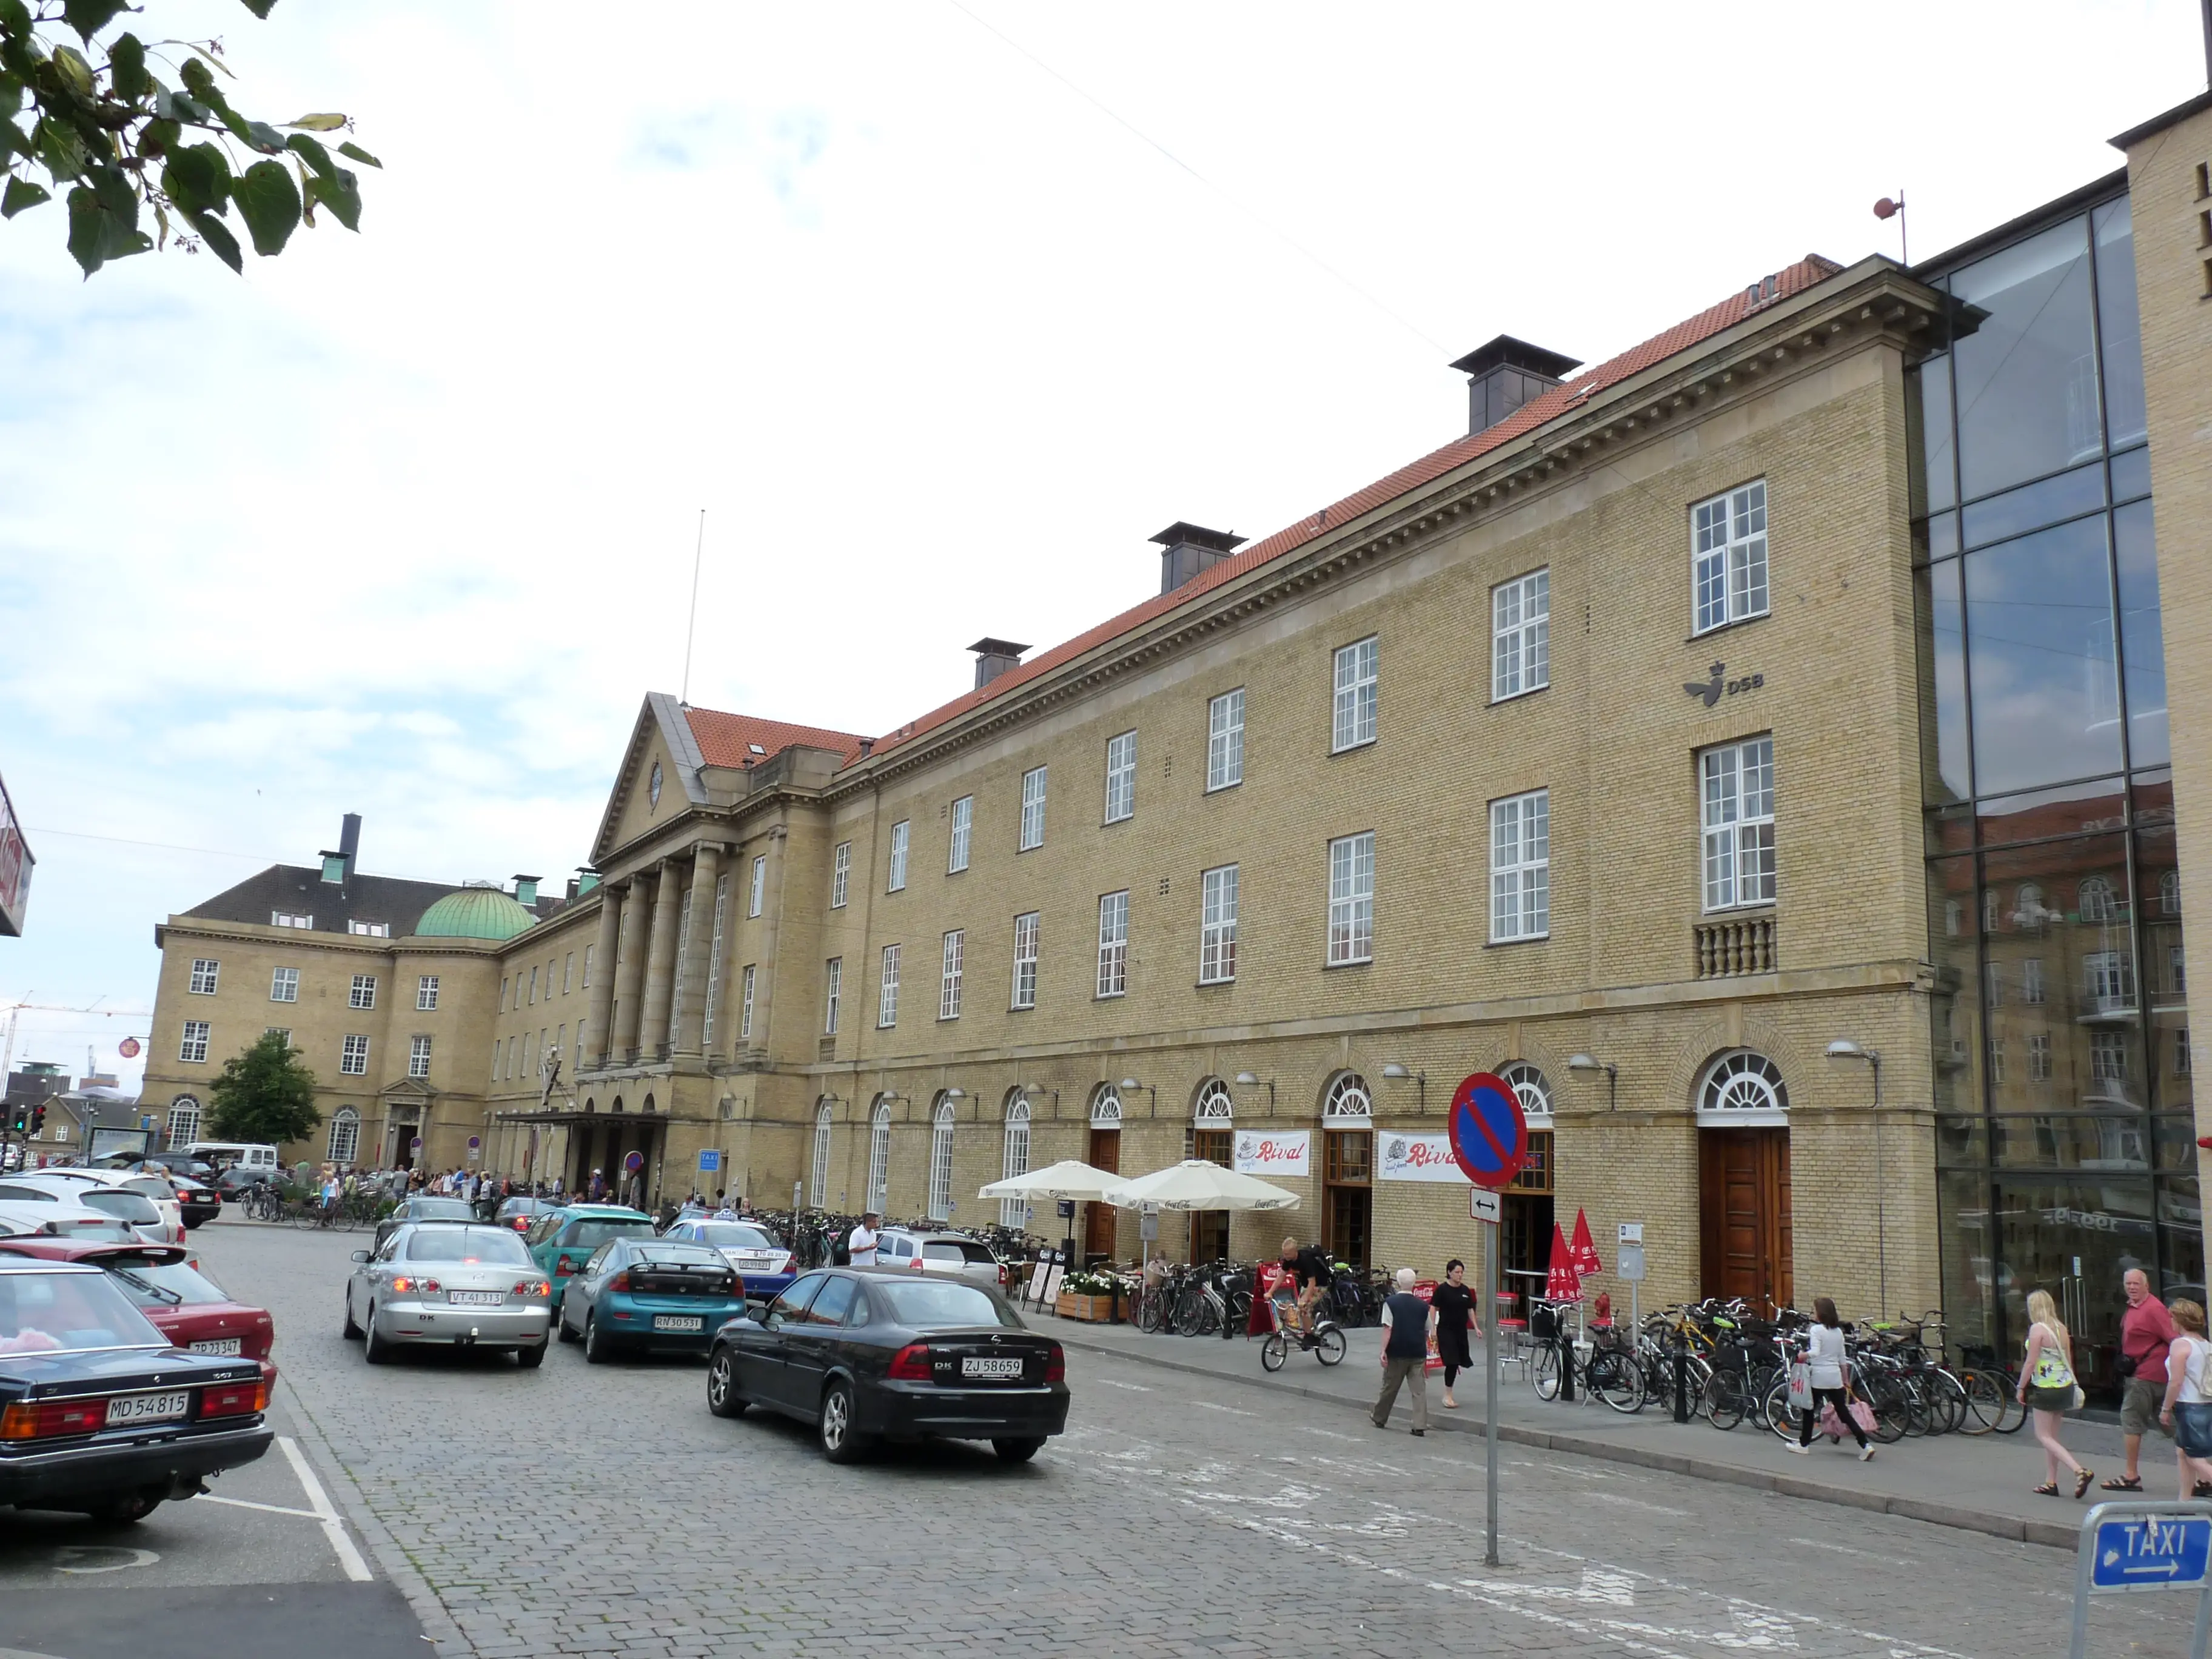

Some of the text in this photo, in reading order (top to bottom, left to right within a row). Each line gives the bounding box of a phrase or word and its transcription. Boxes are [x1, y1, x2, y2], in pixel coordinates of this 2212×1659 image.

[1727, 674, 1764, 695] DSB
[1255, 1141, 1305, 1162] Rival
[1406, 1143, 1458, 1167] Riva
[482, 1293, 500, 1302] 313
[657, 1318, 670, 1326] RN
[222, 1341, 237, 1354] 347
[965, 1360, 980, 1372] ZJ
[110, 1401, 132, 1418] MD
[2124, 1524, 2186, 1557] TAXI
